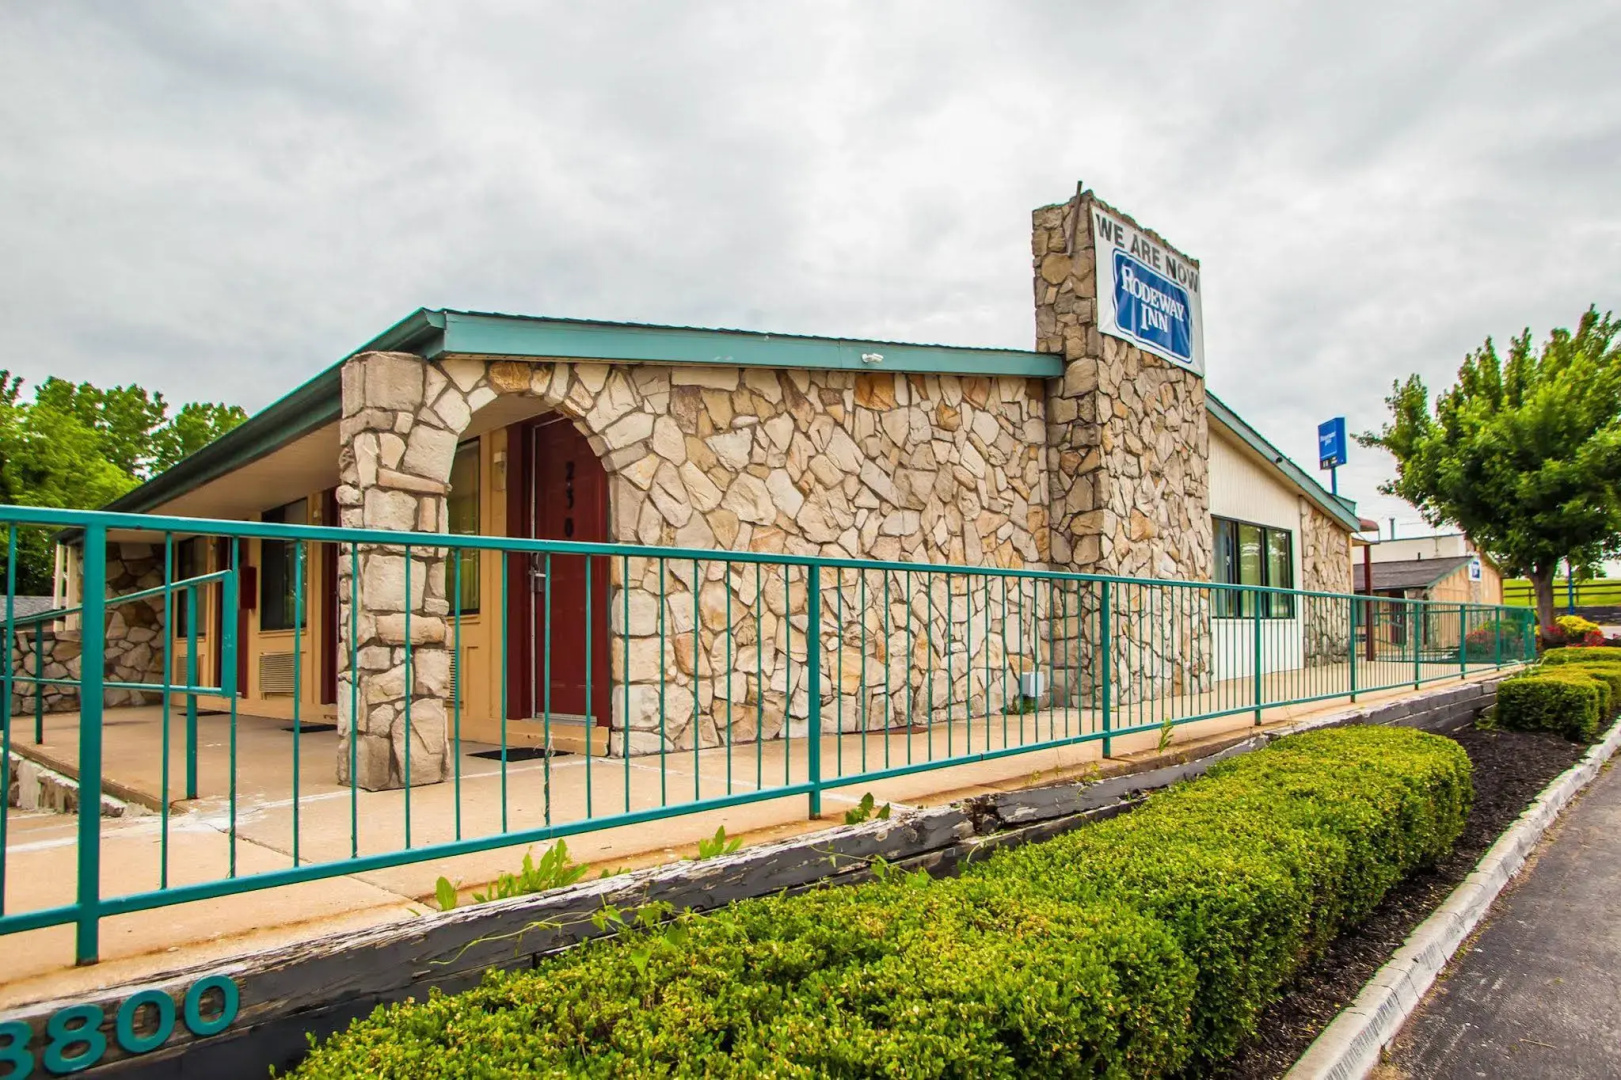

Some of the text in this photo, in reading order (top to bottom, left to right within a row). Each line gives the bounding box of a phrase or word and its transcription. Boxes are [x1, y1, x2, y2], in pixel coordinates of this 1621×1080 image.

[1096, 213, 1199, 293] WE ARE NOW
[1121, 265, 1184, 322] RODEWAY
[1140, 302, 1169, 333] INN
